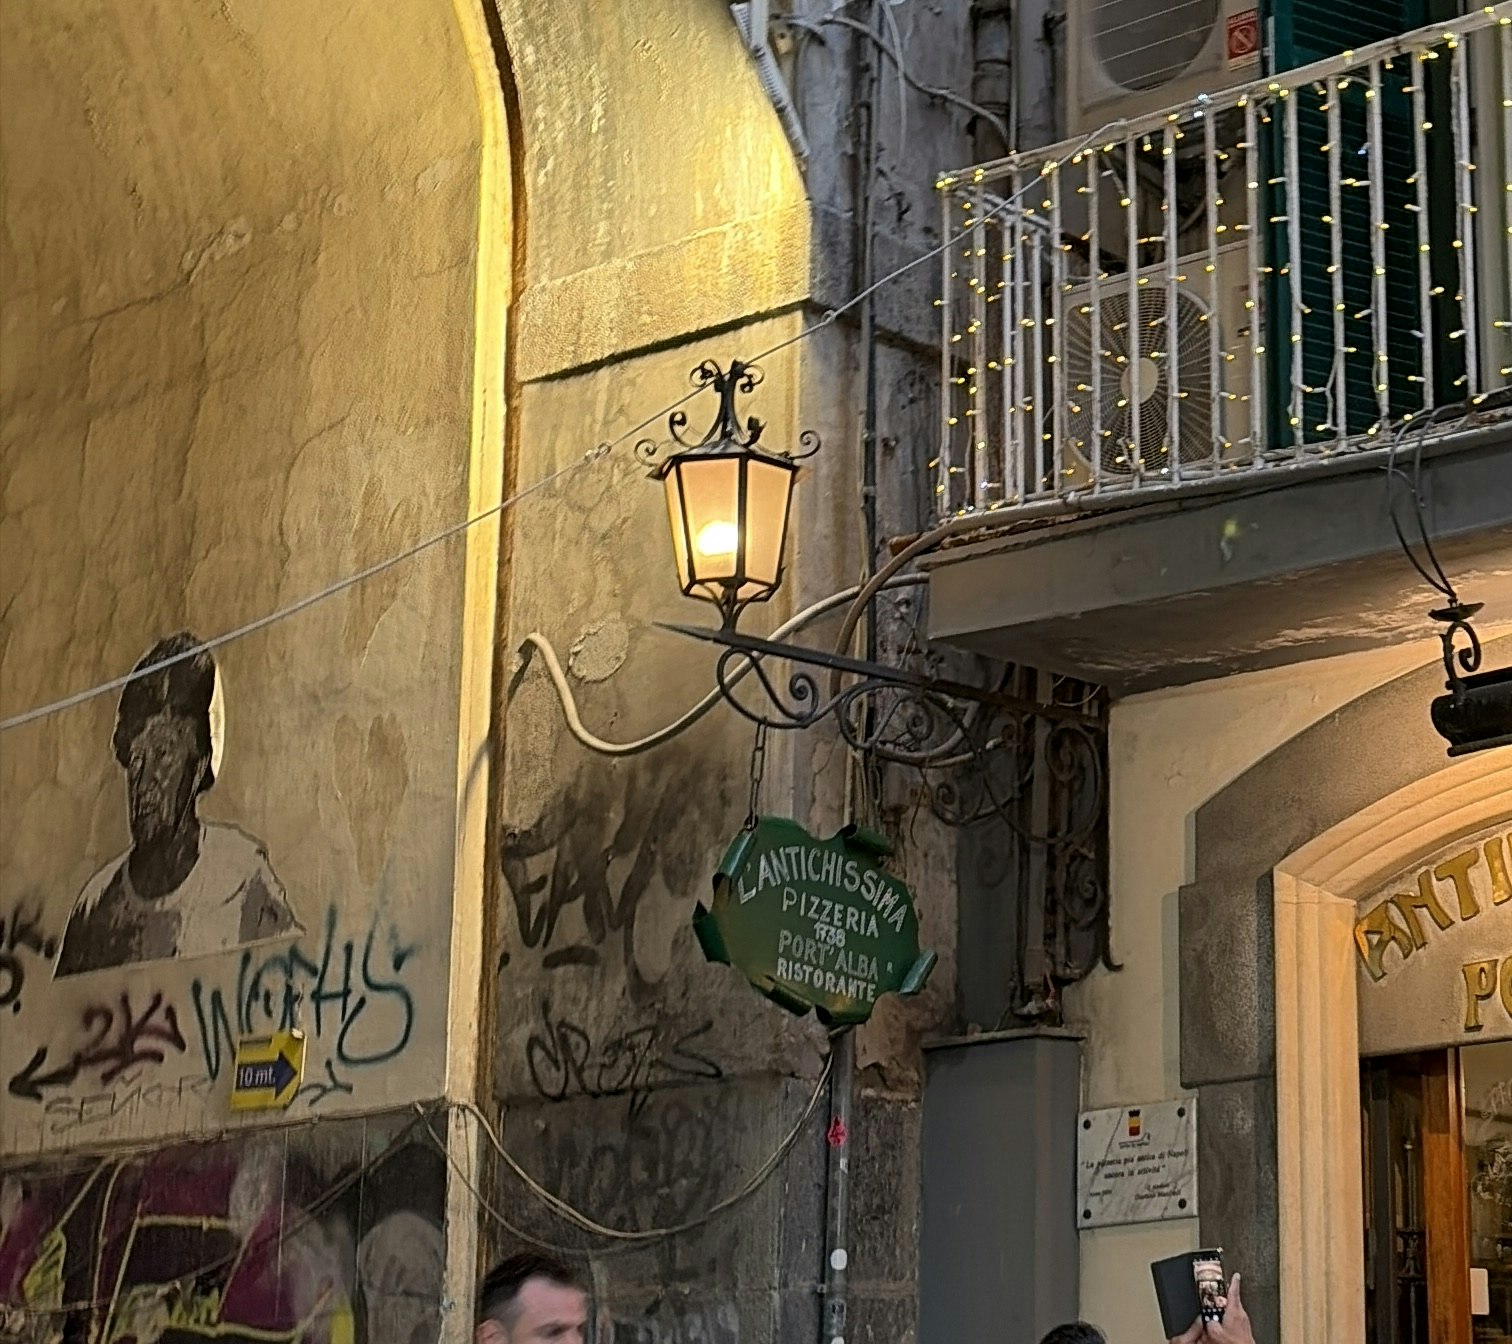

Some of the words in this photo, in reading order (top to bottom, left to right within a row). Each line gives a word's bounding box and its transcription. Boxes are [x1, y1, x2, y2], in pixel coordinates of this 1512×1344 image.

[737, 846, 908, 932] L'ANTICHISSIMA
[782, 887, 879, 938] PIZZERIA
[813, 922, 846, 947] 1738
[776, 957, 877, 1003] RISTORANTE
[239, 1067, 254, 1087] 10
